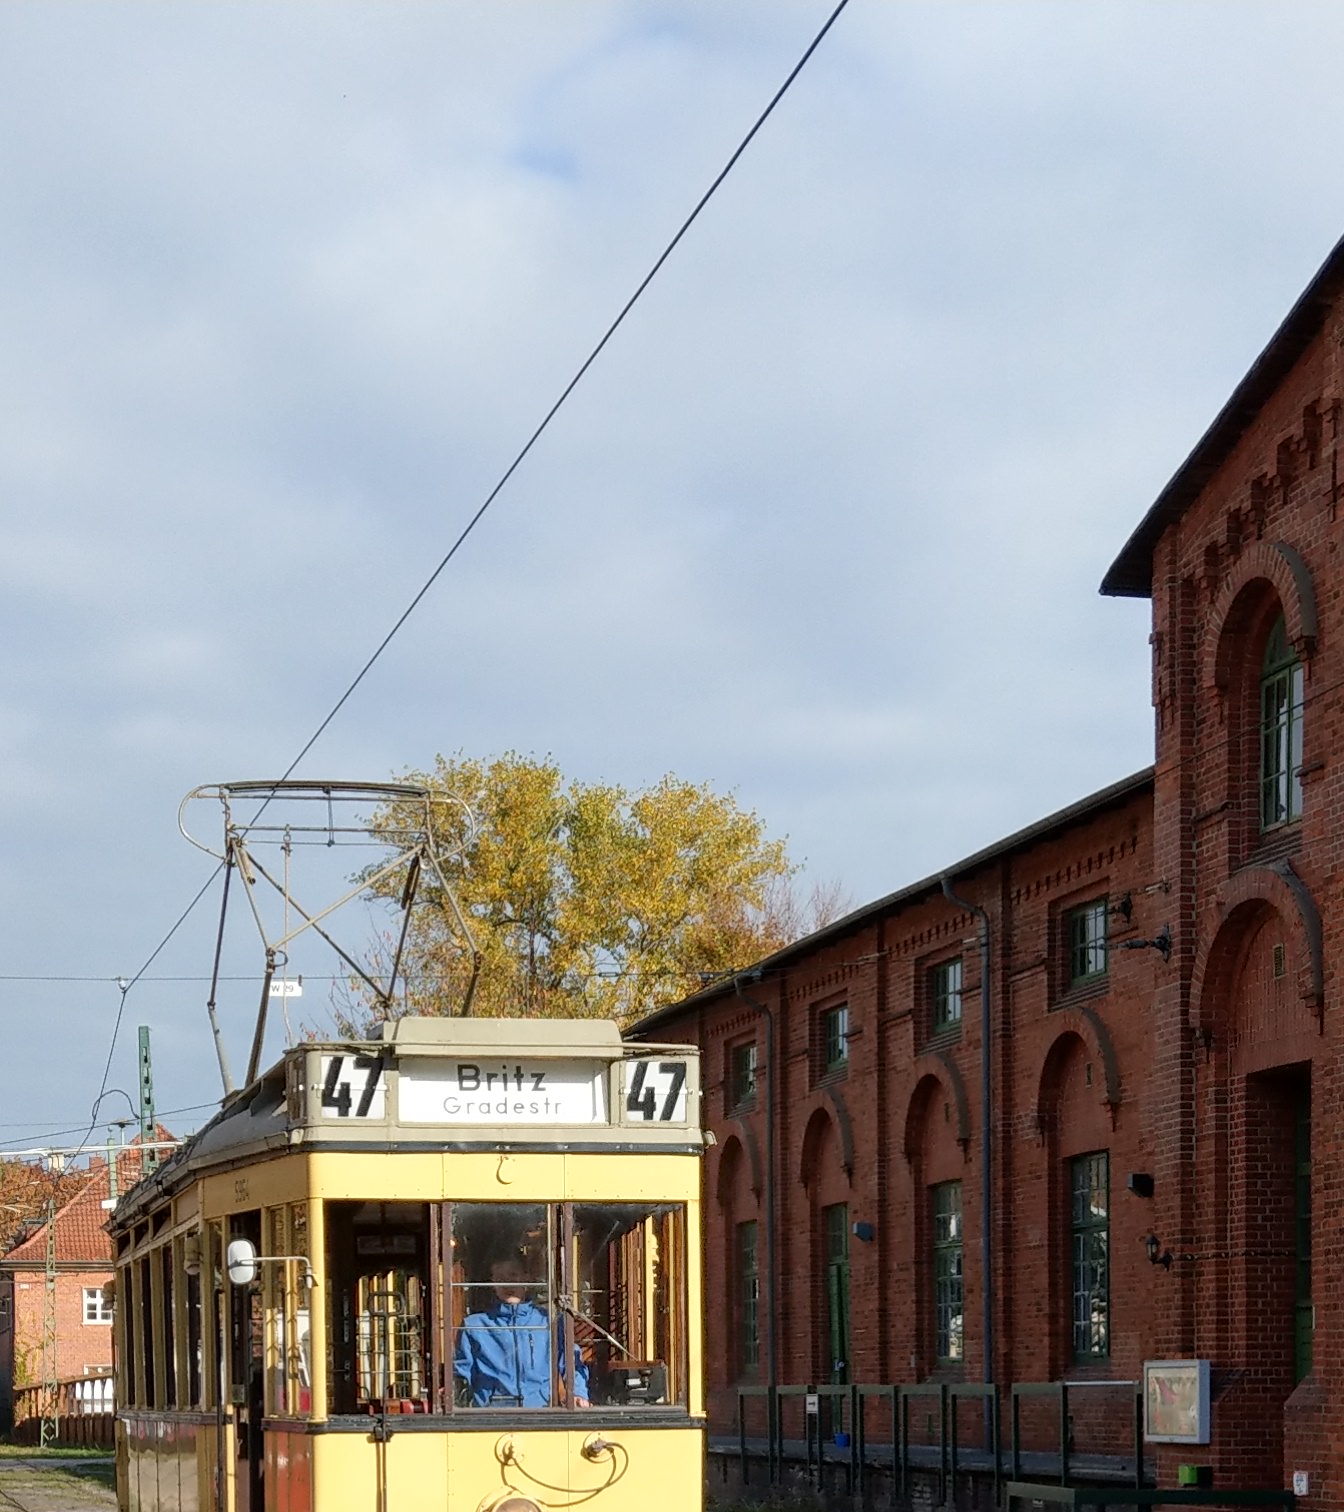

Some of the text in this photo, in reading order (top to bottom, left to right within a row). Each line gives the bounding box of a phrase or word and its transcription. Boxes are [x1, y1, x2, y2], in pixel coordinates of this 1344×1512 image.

[321, 1056, 384, 1117] 47
[457, 1064, 546, 1091] Britz
[626, 1061, 687, 1121] 47
[443, 1096, 562, 1114] Gradestr
